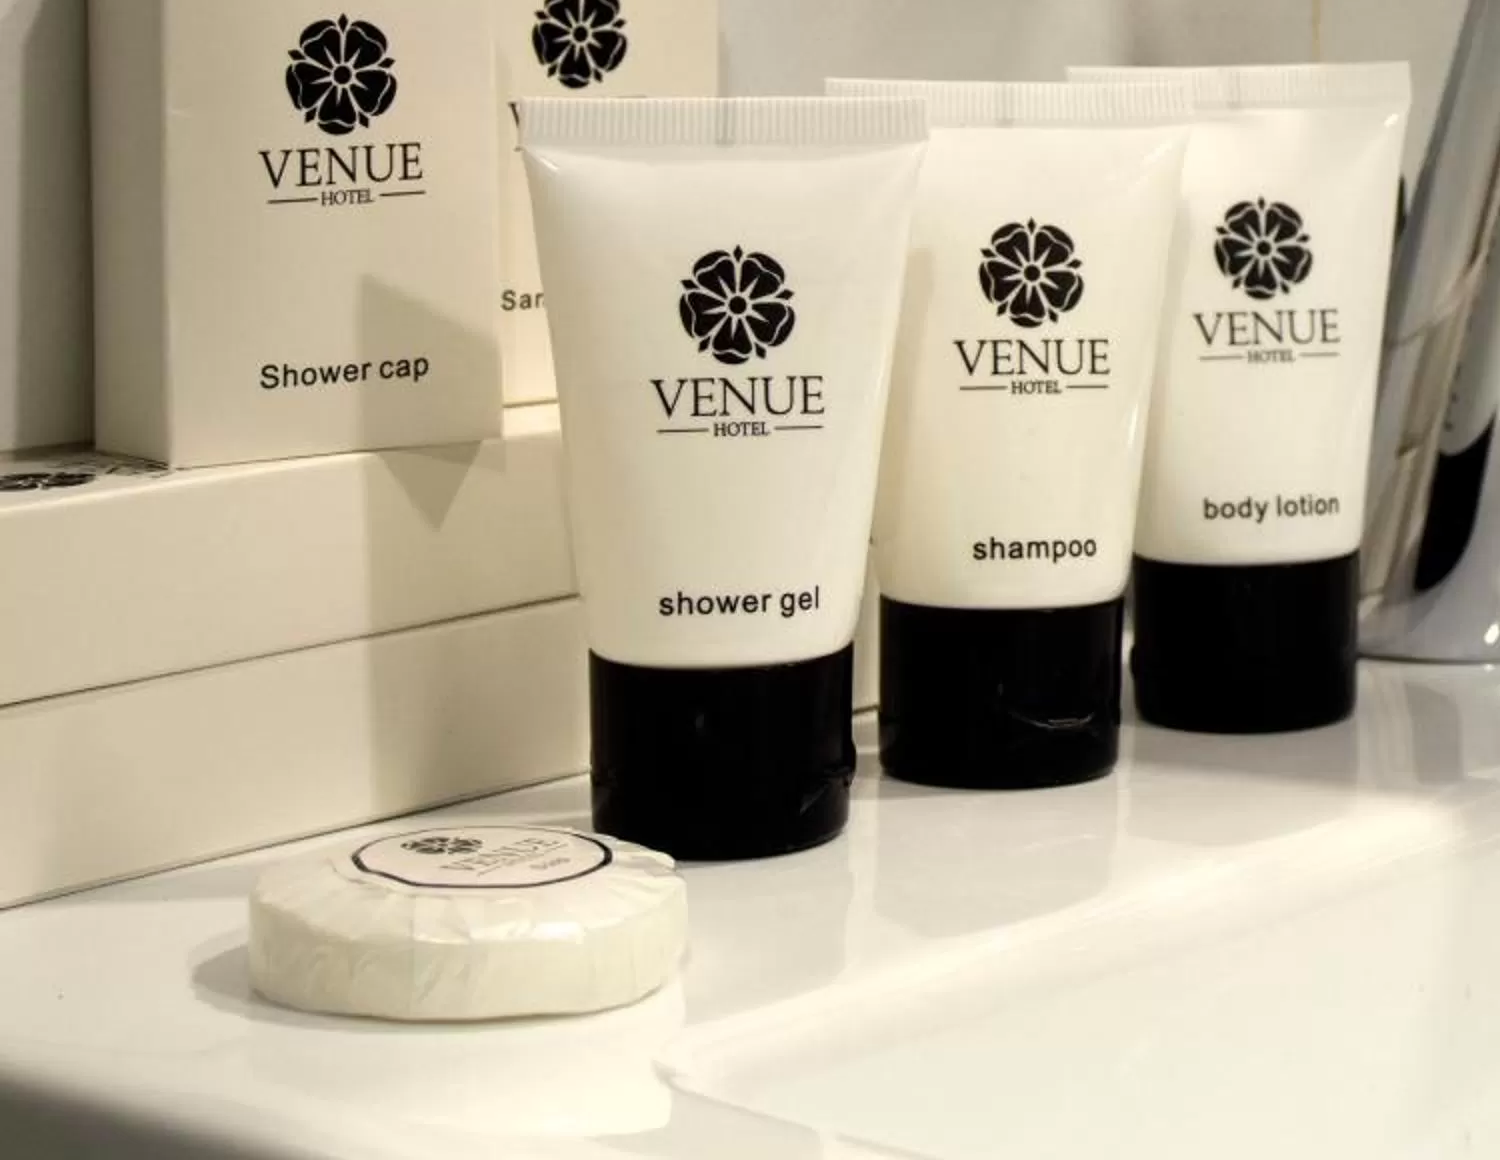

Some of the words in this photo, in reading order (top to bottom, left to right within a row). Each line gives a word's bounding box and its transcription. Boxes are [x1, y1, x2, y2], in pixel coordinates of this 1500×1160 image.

[259, 142, 424, 188] VENUE
[321, 188, 374, 206] HOTEL
[1192, 308, 1341, 346] VENUE
[953, 338, 1111, 377] VENUE
[1246, 349, 1294, 363] HOTEL
[259, 362, 373, 390] Shower
[379, 357, 430, 383] cap
[1010, 380, 1062, 395] HOTEL
[651, 375, 825, 418] VENUE
[713, 421, 770, 437] HOTEL
[1203, 497, 1268, 524] body
[1276, 494, 1340, 518] lotion
[972, 536, 1097, 564] shampoo
[658, 591, 772, 617] shower
[779, 585, 820, 619] gel
